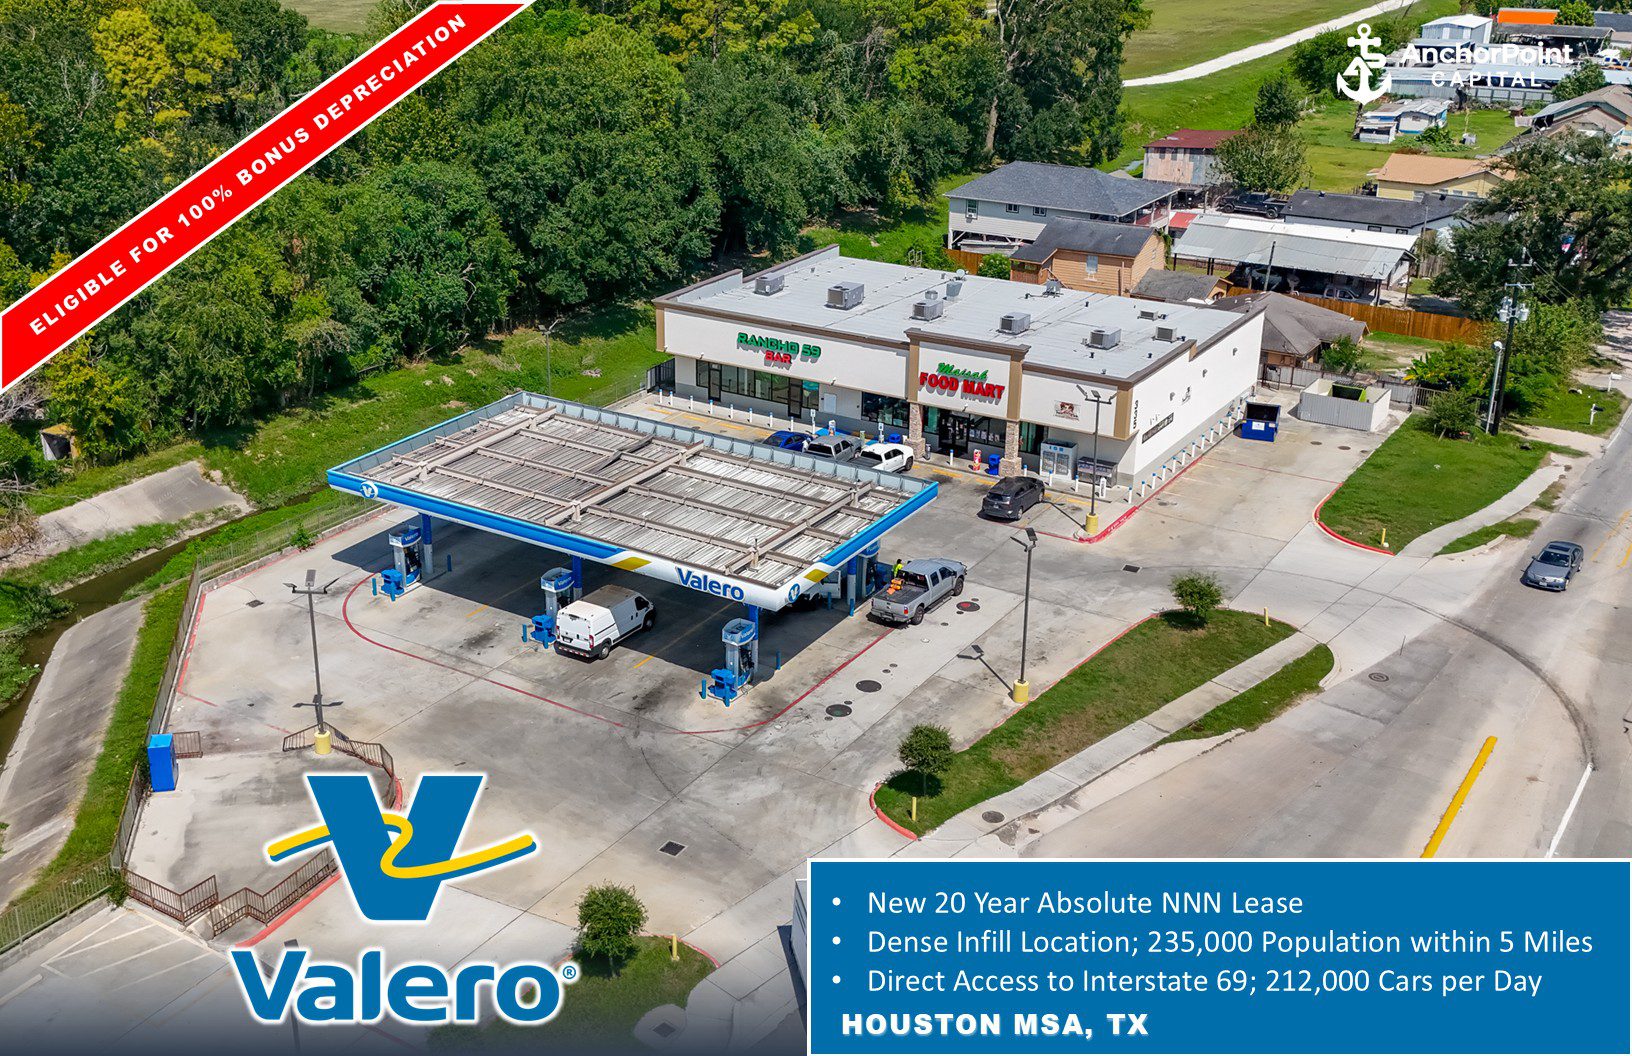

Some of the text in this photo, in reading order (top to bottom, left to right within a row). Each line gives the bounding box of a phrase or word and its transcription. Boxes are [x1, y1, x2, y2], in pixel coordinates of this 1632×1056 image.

[737, 332, 821, 359] RANCHO 59
[765, 350, 792, 364] BAR
[919, 372, 1005, 399] FOOD MART
[676, 567, 745, 601] Valero
